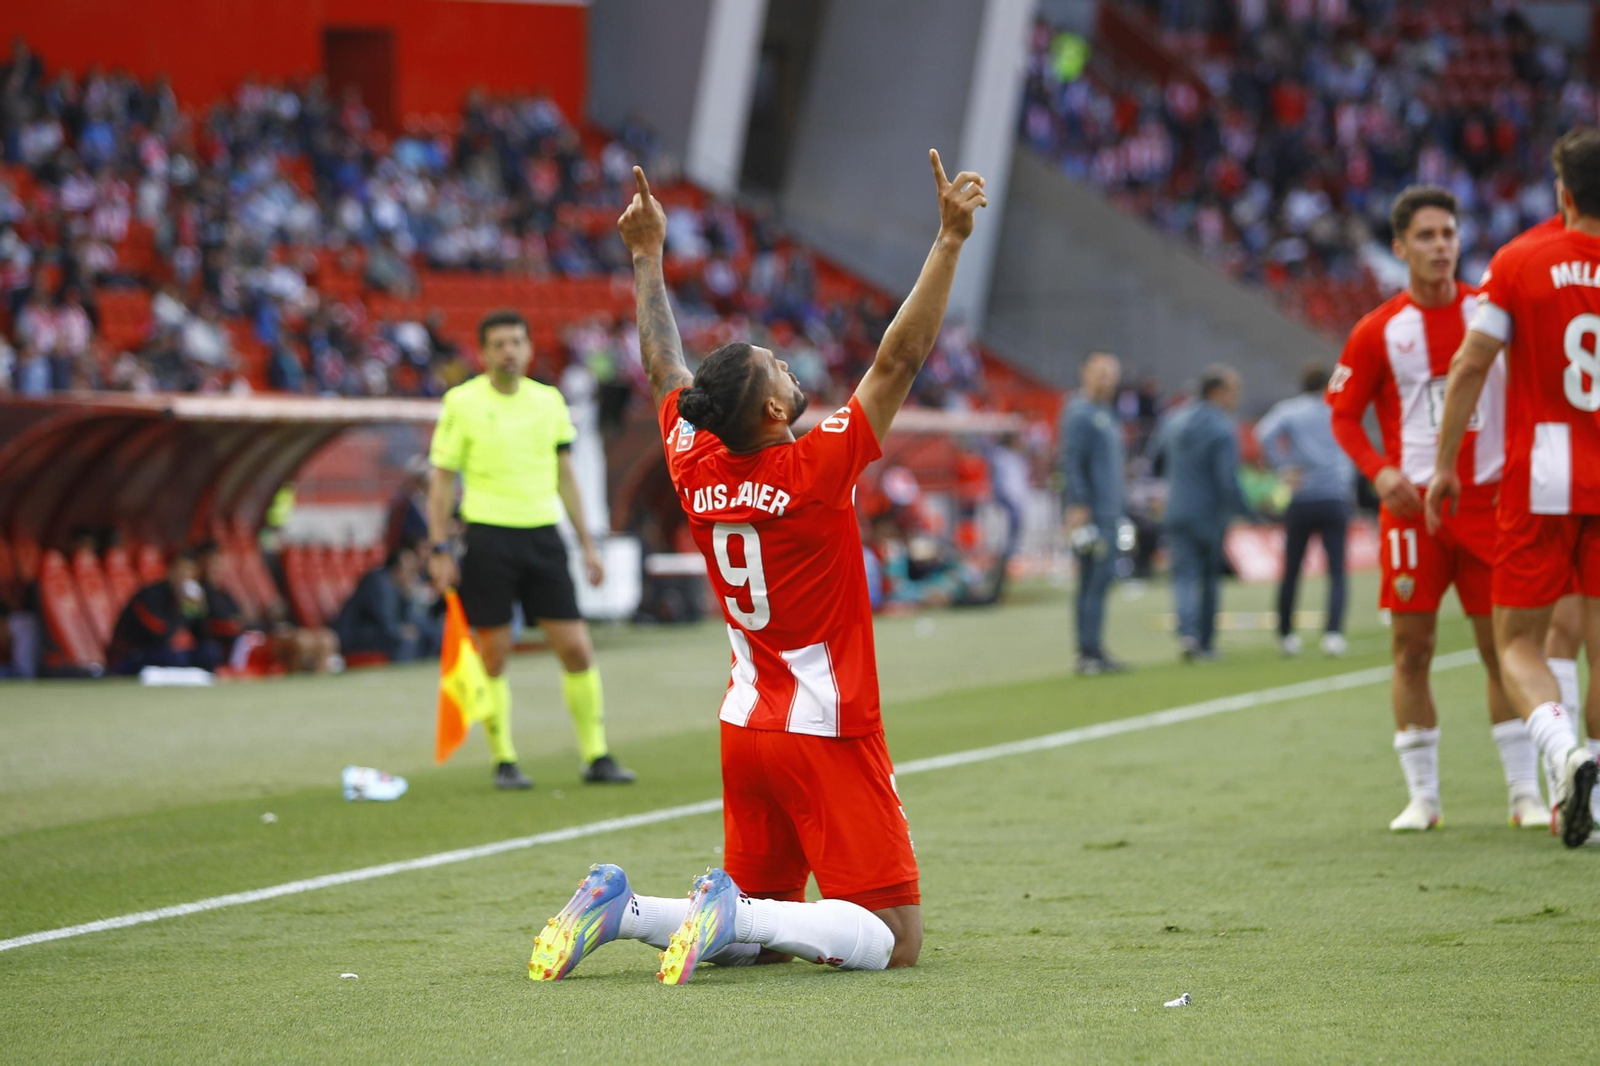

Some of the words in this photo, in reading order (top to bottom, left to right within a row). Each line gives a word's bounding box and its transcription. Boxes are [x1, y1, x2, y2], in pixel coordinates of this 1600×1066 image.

[1563, 312, 1600, 412] 8
[684, 484, 727, 513] UIS
[712, 522, 771, 631] 9
[1387, 527, 1418, 570] 11
